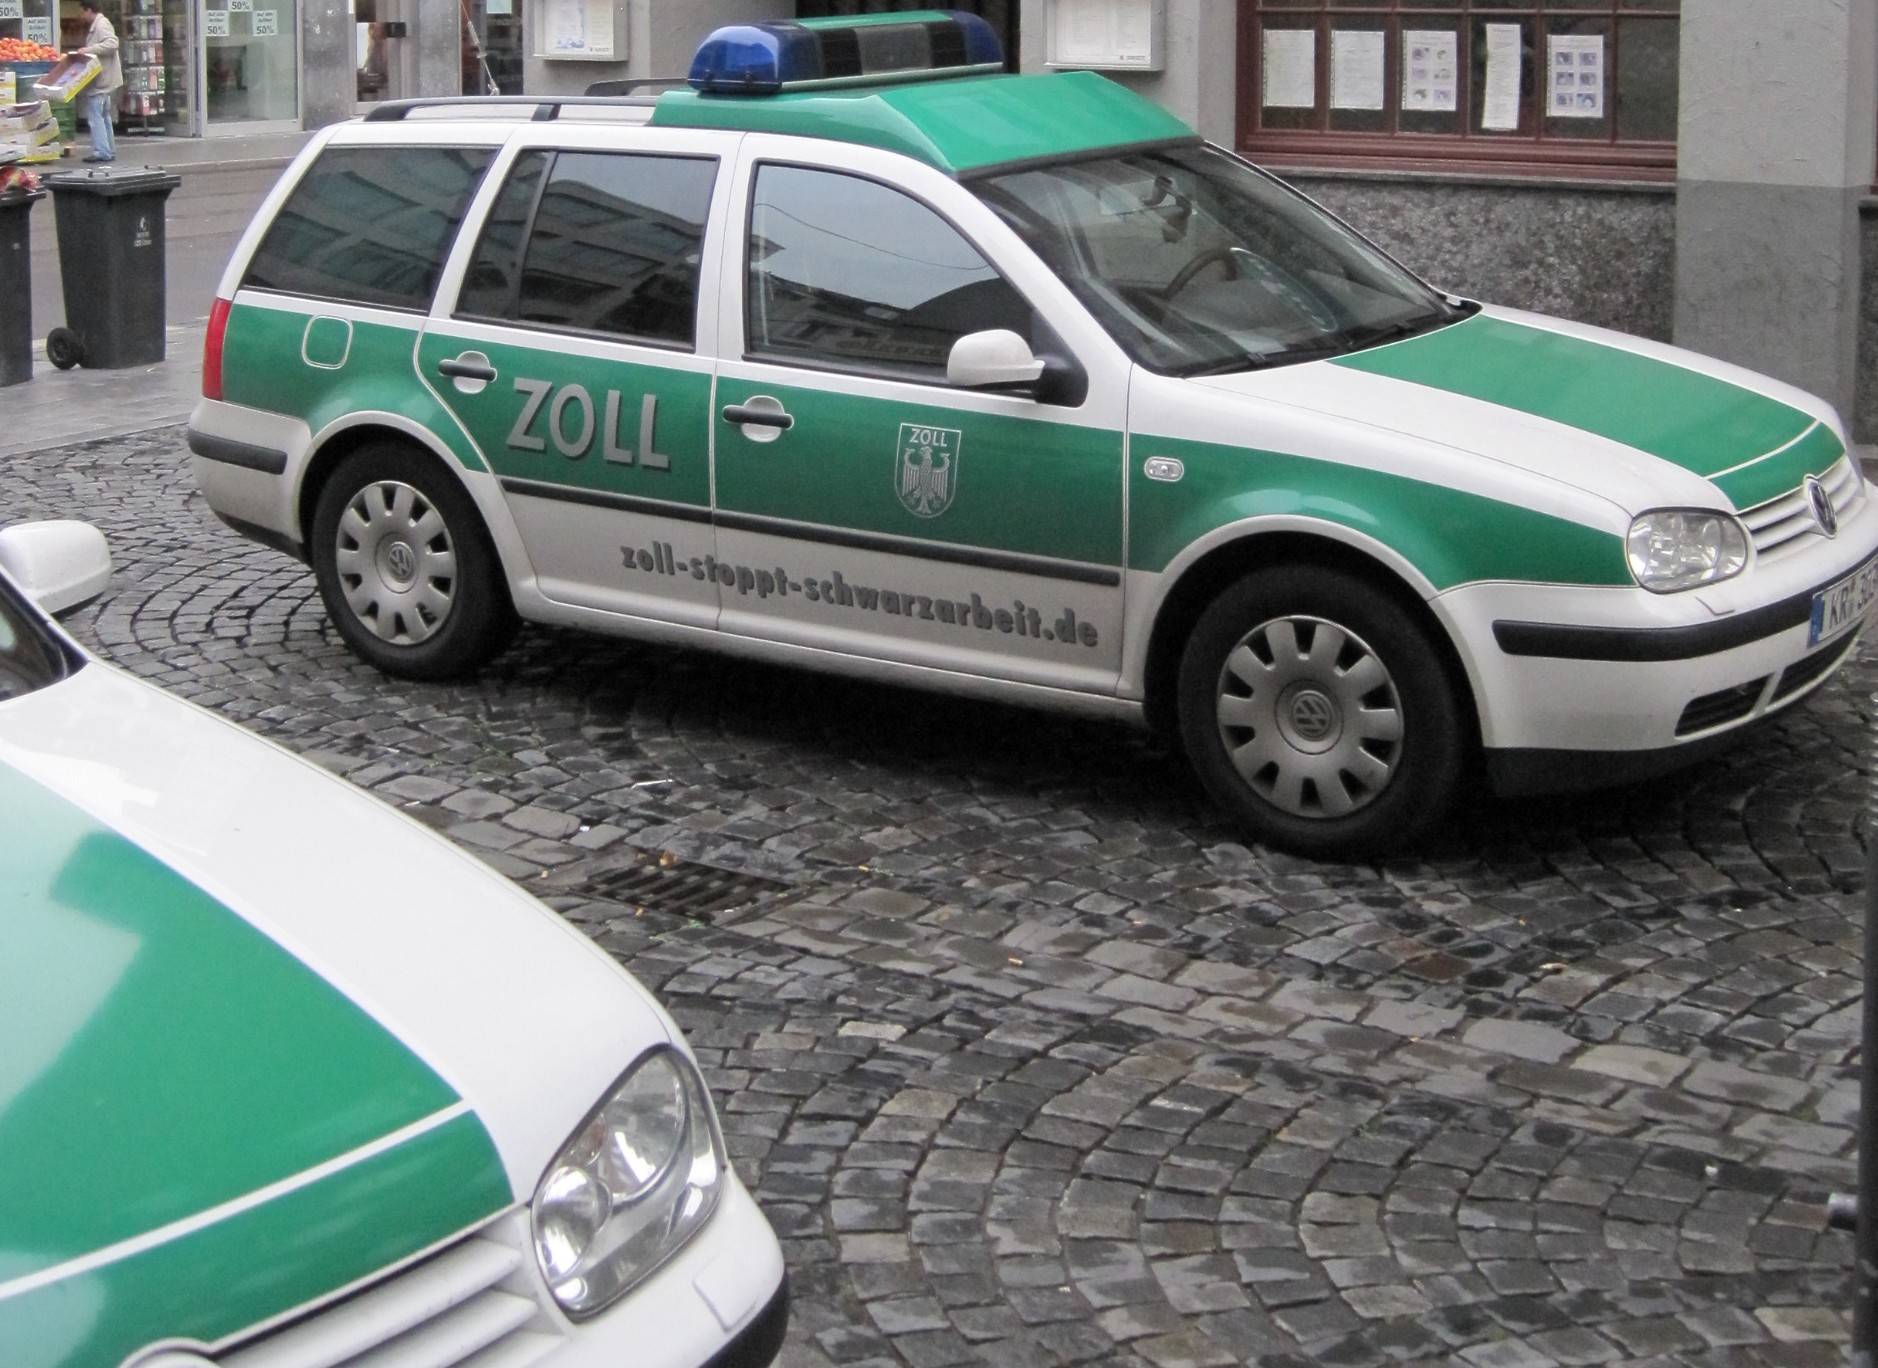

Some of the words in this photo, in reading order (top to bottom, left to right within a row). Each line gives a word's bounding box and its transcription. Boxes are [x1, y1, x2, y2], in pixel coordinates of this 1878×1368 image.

[231, 1, 250, 9] 50%
[0, 7, 19, 16] 50%
[207, 25, 226, 34] 50%
[256, 25, 275, 34] 50%
[28, 33, 48, 43] 50%
[506, 377, 670, 470] ZOLL
[909, 427, 948, 447] ZOLL
[620, 541, 1098, 647] zoll-stoppt-schwarzarbeit.de
